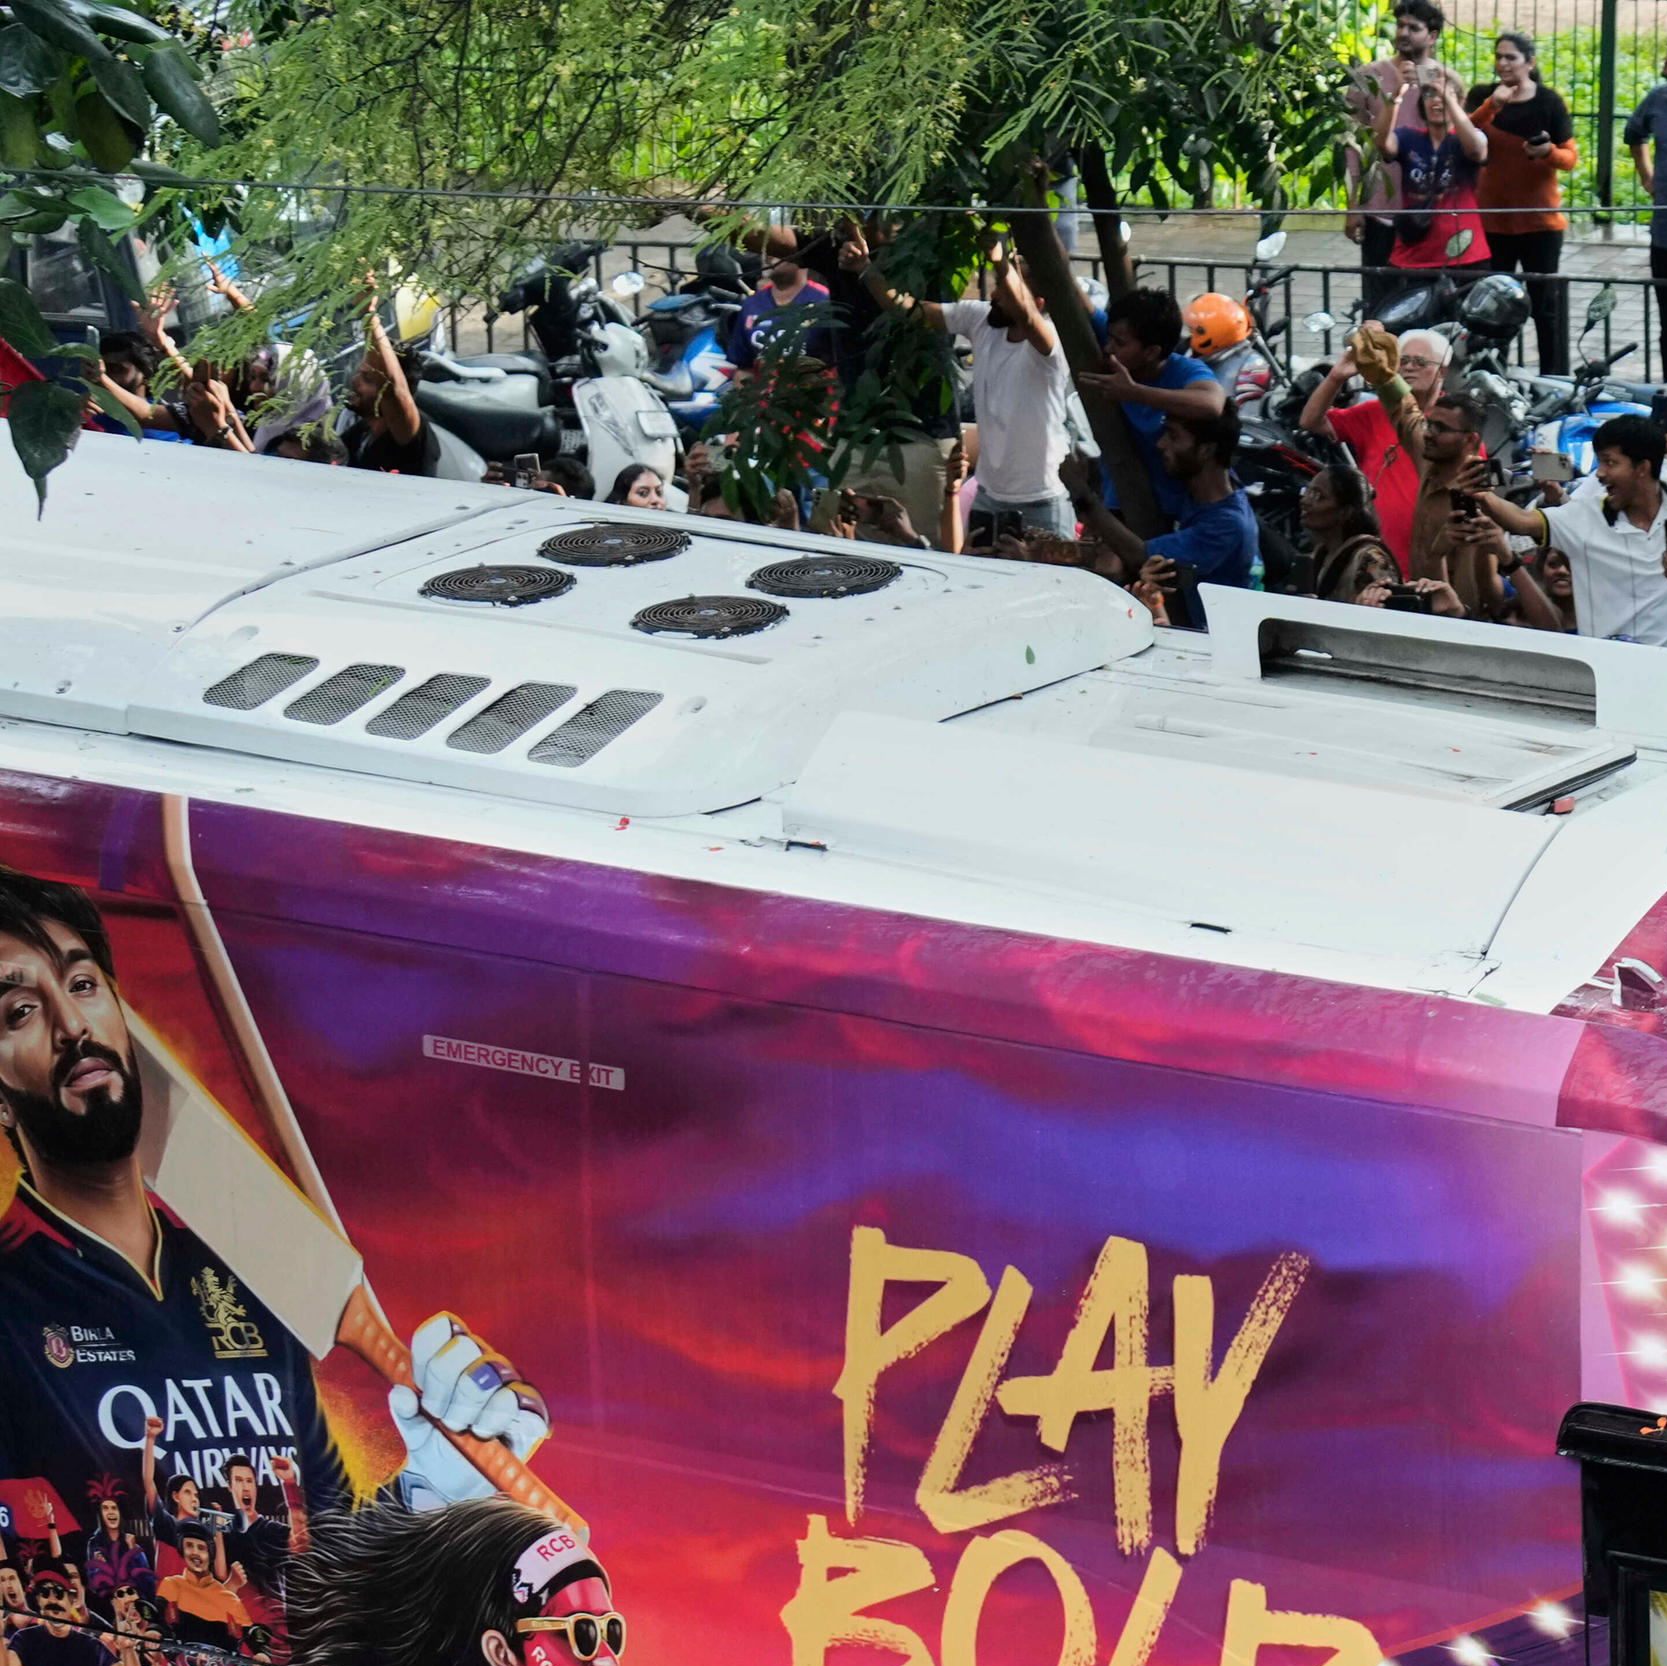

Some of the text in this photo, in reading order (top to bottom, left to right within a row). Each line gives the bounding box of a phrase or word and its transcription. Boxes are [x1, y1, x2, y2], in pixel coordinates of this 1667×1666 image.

[433, 1038, 563, 1077] EMERGENCY
[76, 1349, 136, 1363] ESTATES
[833, 1225, 1311, 1557] PLAY
[97, 1373, 295, 1460] QATAR
[537, 1535, 576, 1562] RCB
